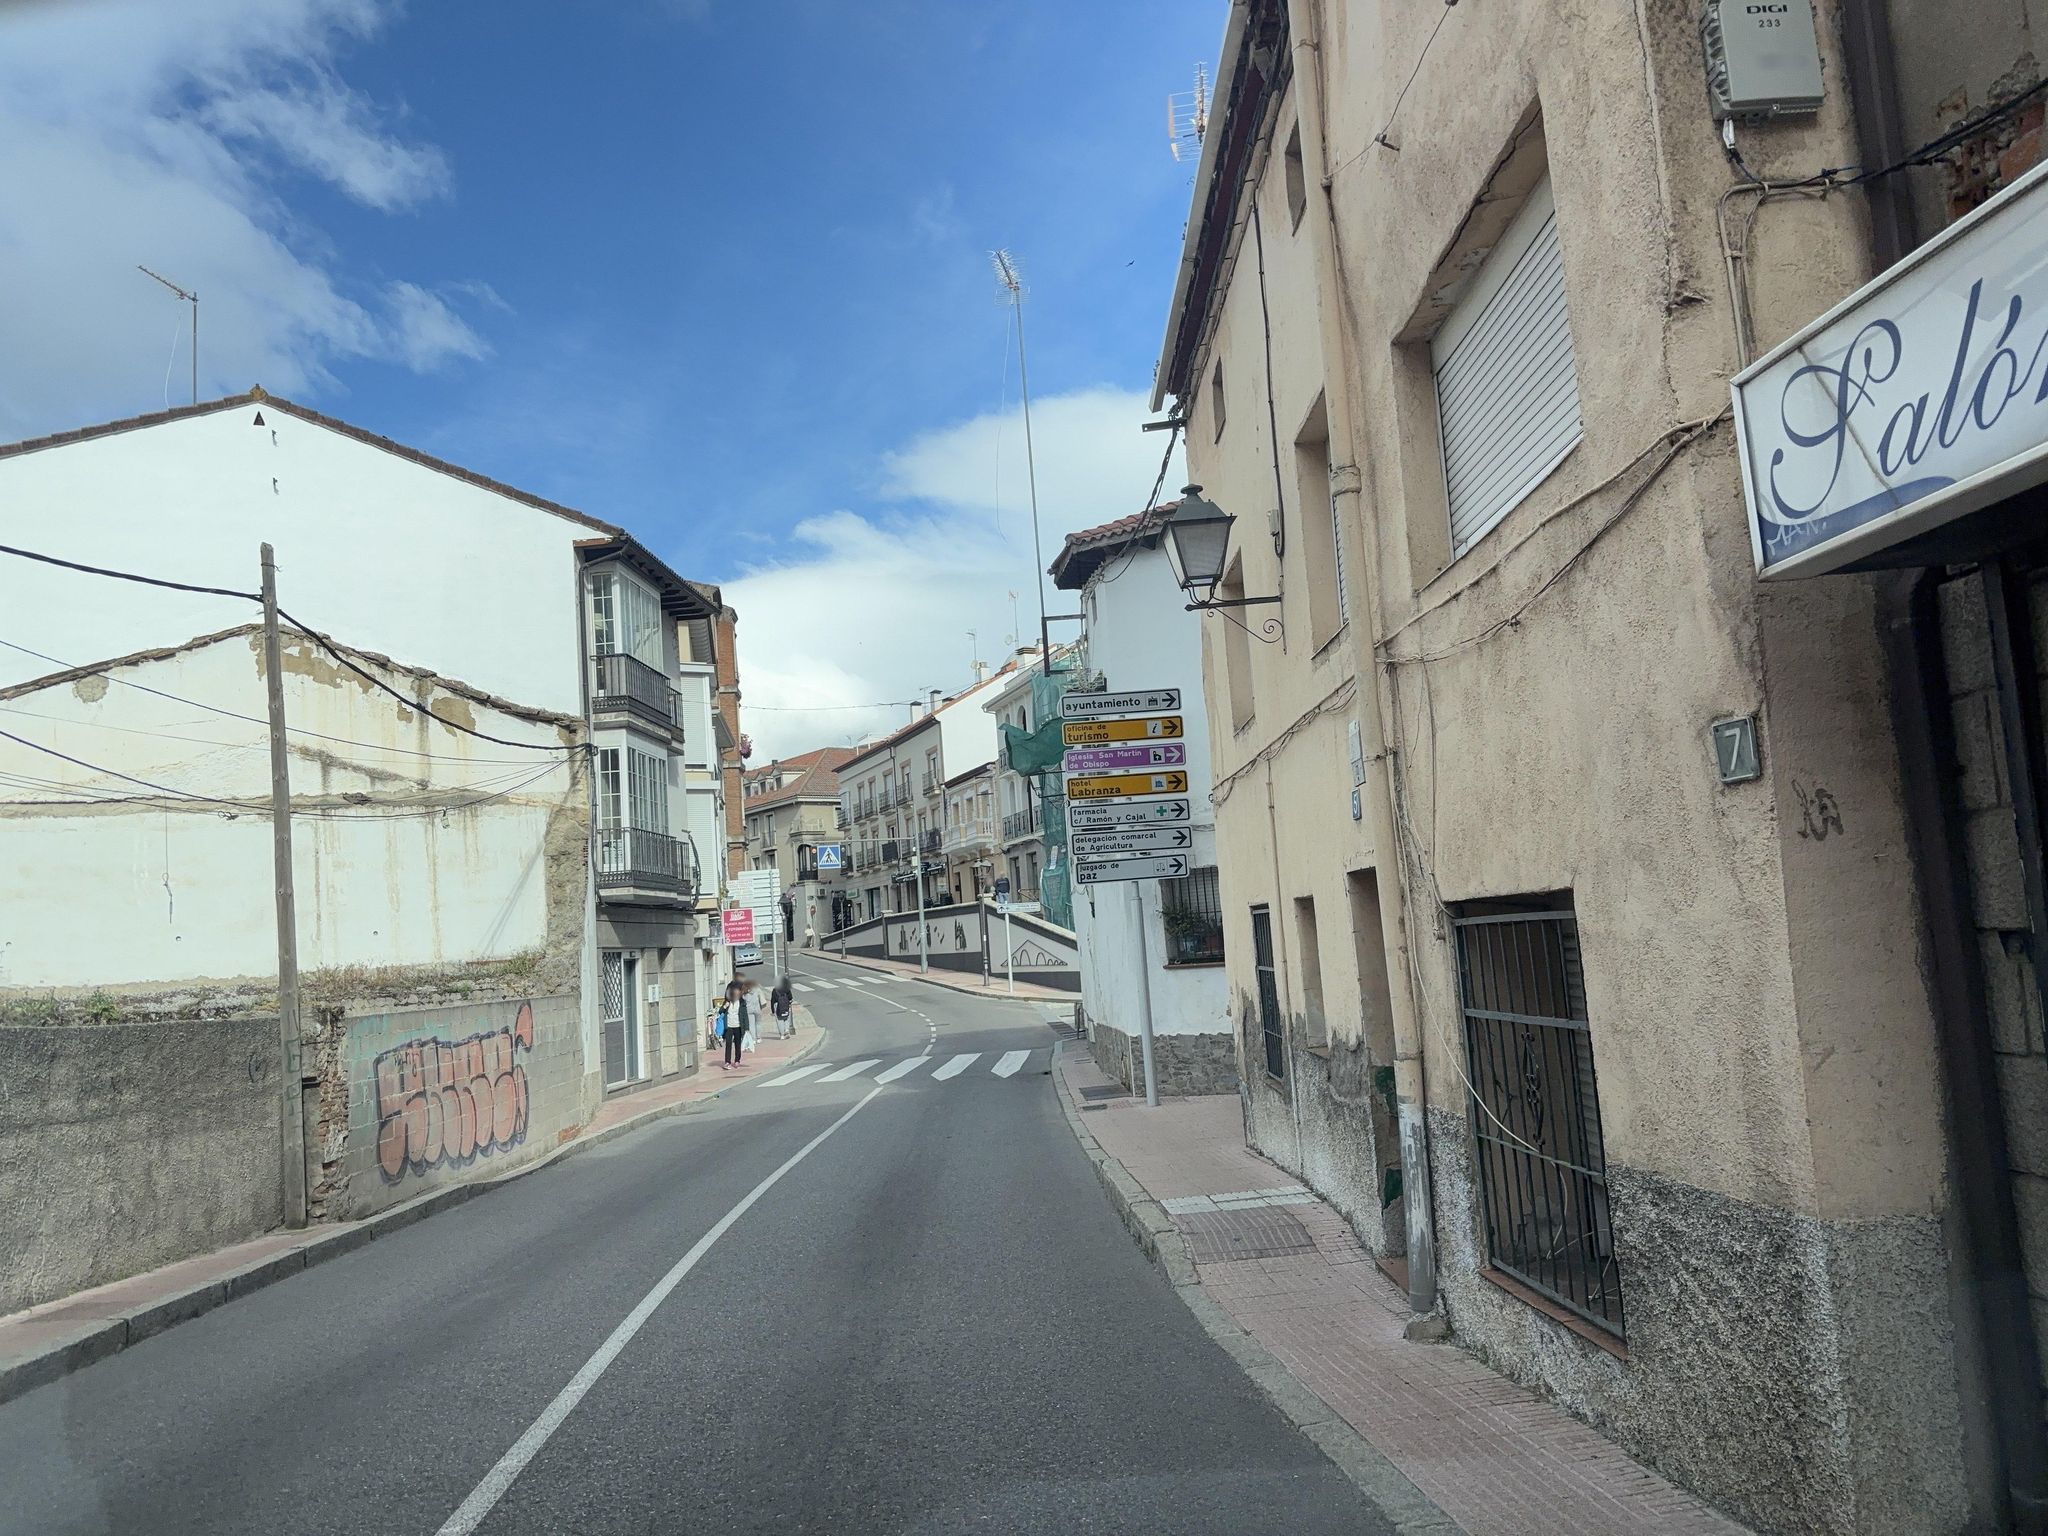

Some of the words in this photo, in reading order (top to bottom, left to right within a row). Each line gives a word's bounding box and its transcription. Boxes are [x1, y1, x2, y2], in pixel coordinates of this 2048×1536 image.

[1746, 4, 1788, 14] DIGI
[1758, 19, 1781, 28] 233
[1769, 277, 2048, 519] Saló
[1065, 697, 1141, 711] ayuntamiento
[1066, 724, 1093, 732] oficina
[1067, 732, 1109, 742] turismo
[1724, 727, 1741, 772] 7
[1098, 751, 1114, 759] San
[1069, 761, 1079, 769] de
[1082, 760, 1110, 770] Obispo
[1070, 779, 1092, 787] hotel
[1071, 786, 1121, 797] Labranza
[1073, 807, 1107, 816] farmacia
[1073, 817, 1082, 825] c/
[1086, 815, 1113, 824] Ramón
[1125, 813, 1147, 822] Cajal
[1121, 832, 1157, 841] comarcal
[1089, 842, 1133, 851] Agricultura
[1079, 862, 1107, 872] juzgado
[1079, 872, 1098, 883] paz
